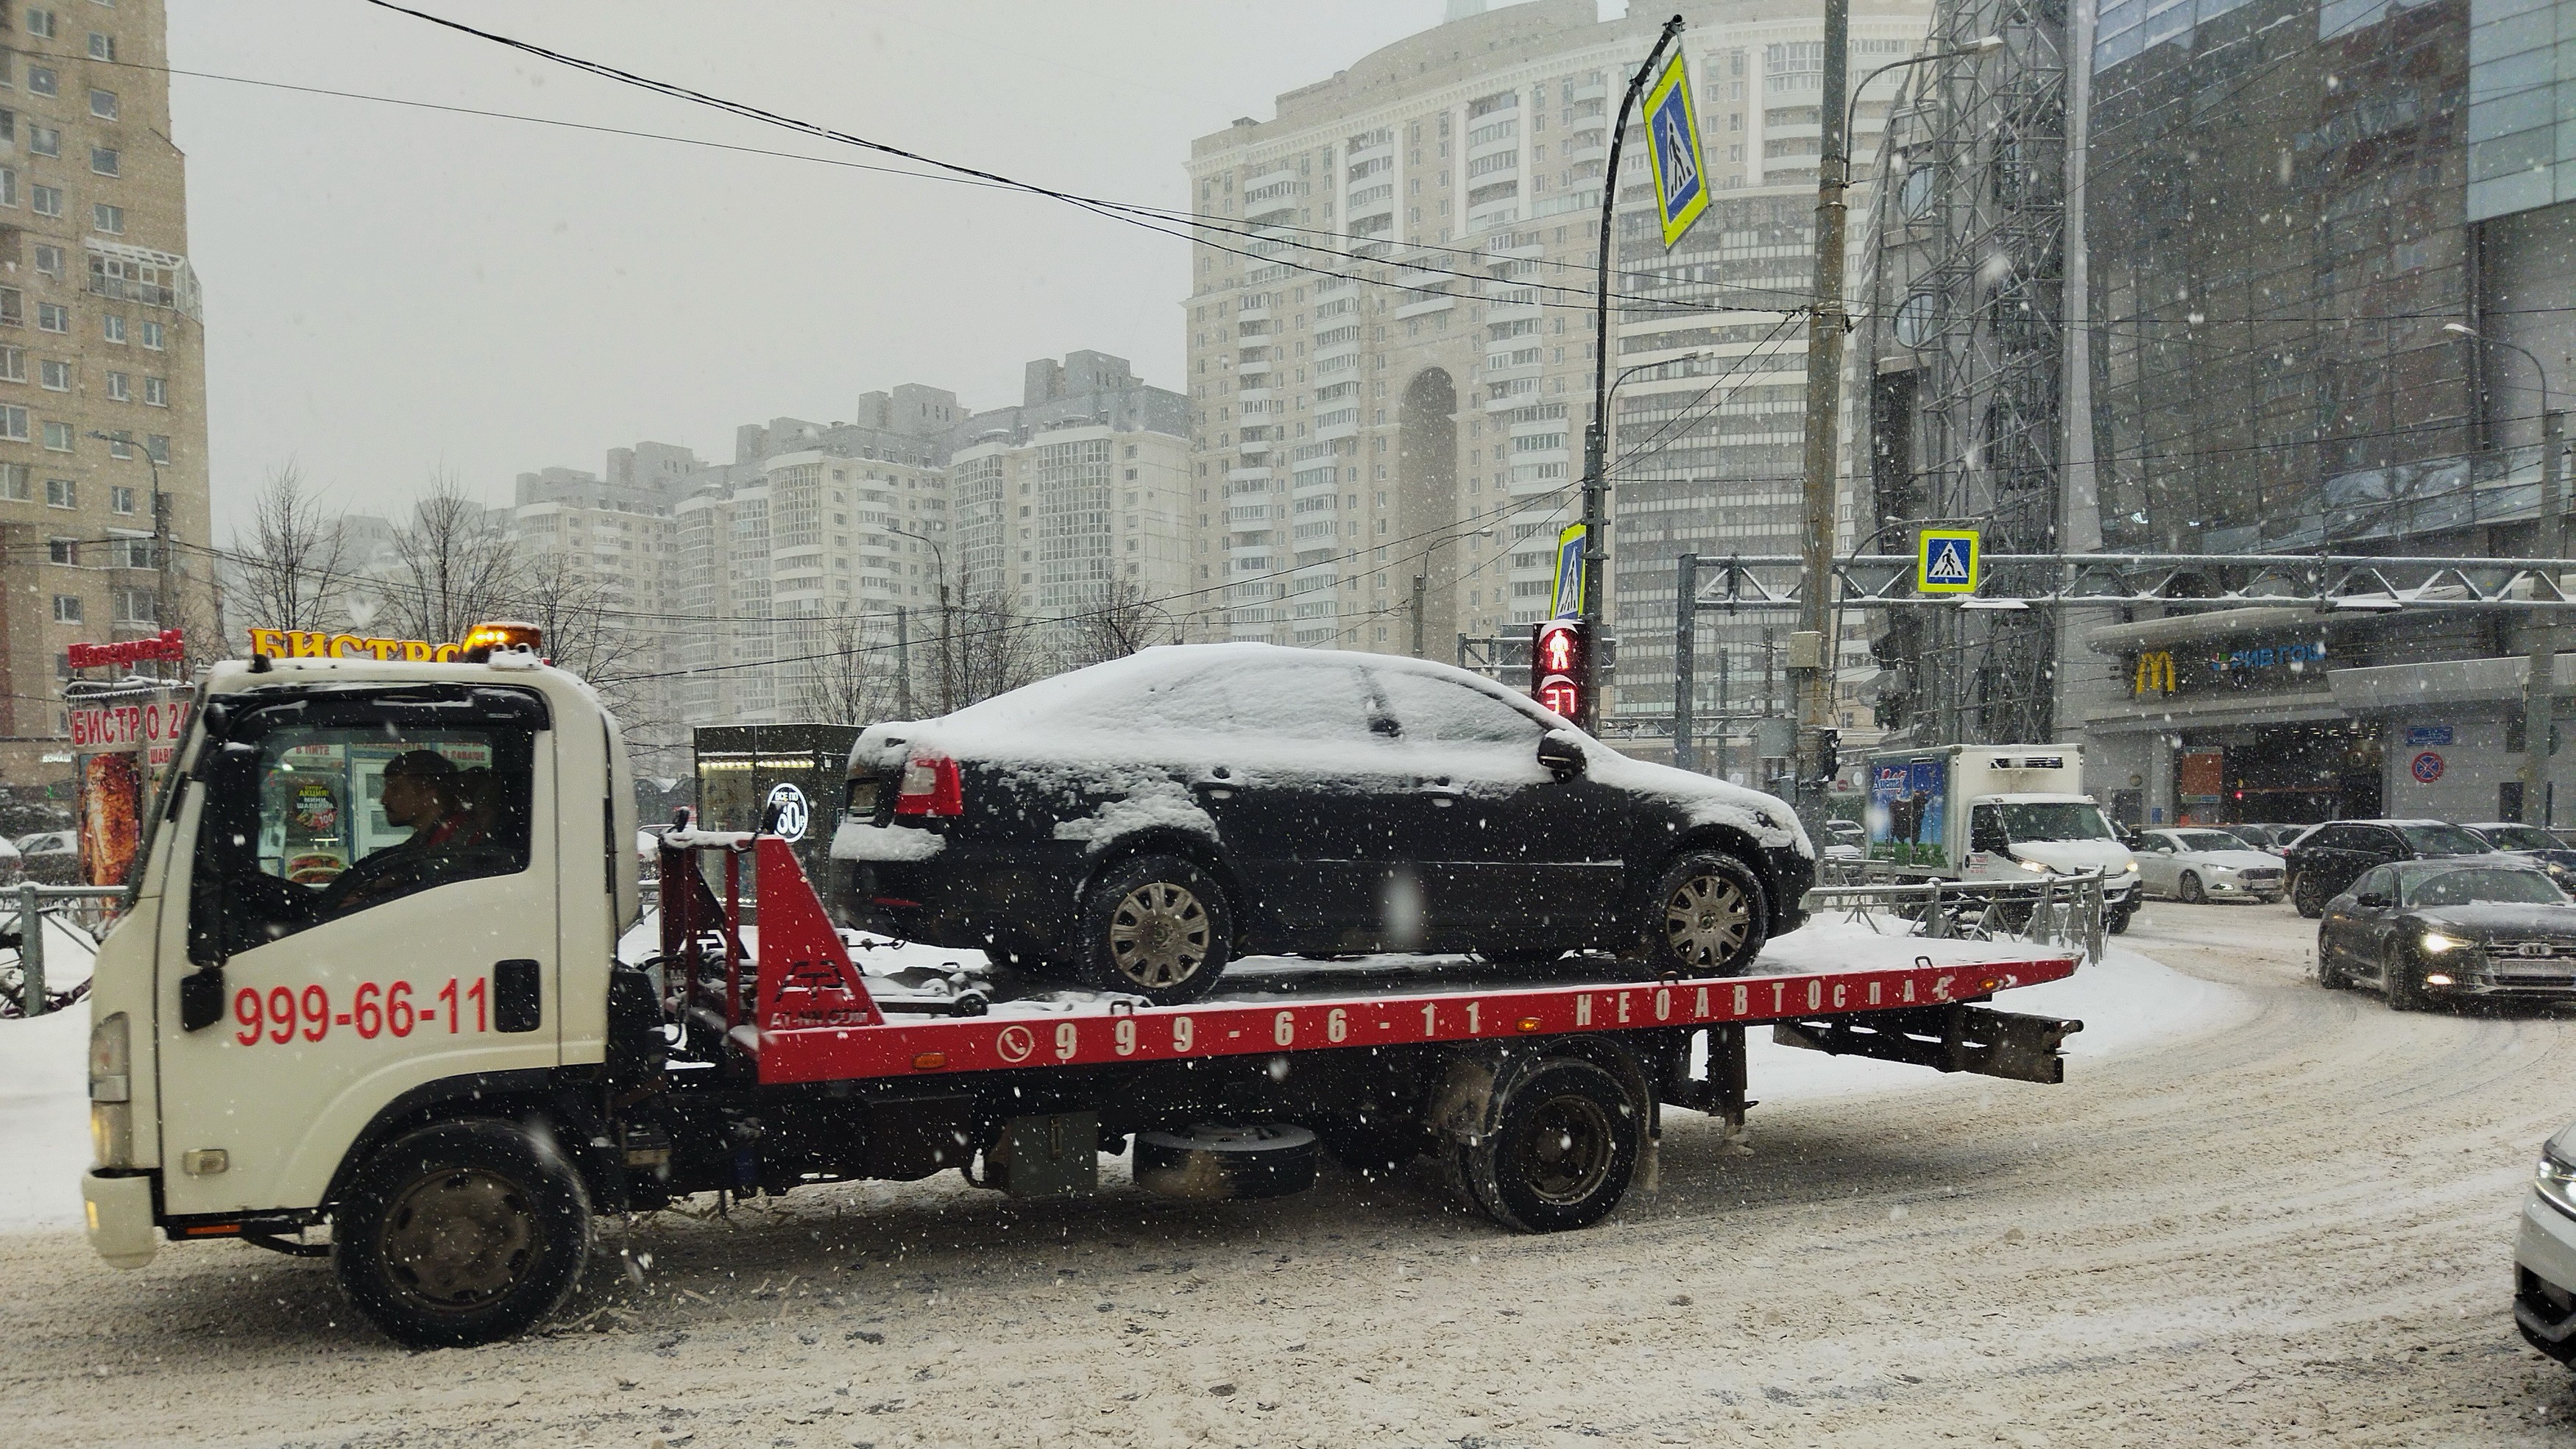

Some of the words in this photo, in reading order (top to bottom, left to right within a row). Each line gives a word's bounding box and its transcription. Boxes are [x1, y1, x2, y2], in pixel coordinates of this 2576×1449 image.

[73, 704, 160, 745] БИСТРО
[319, 812, 333, 823] 100
[233, 977, 486, 1046] 999-66-11
